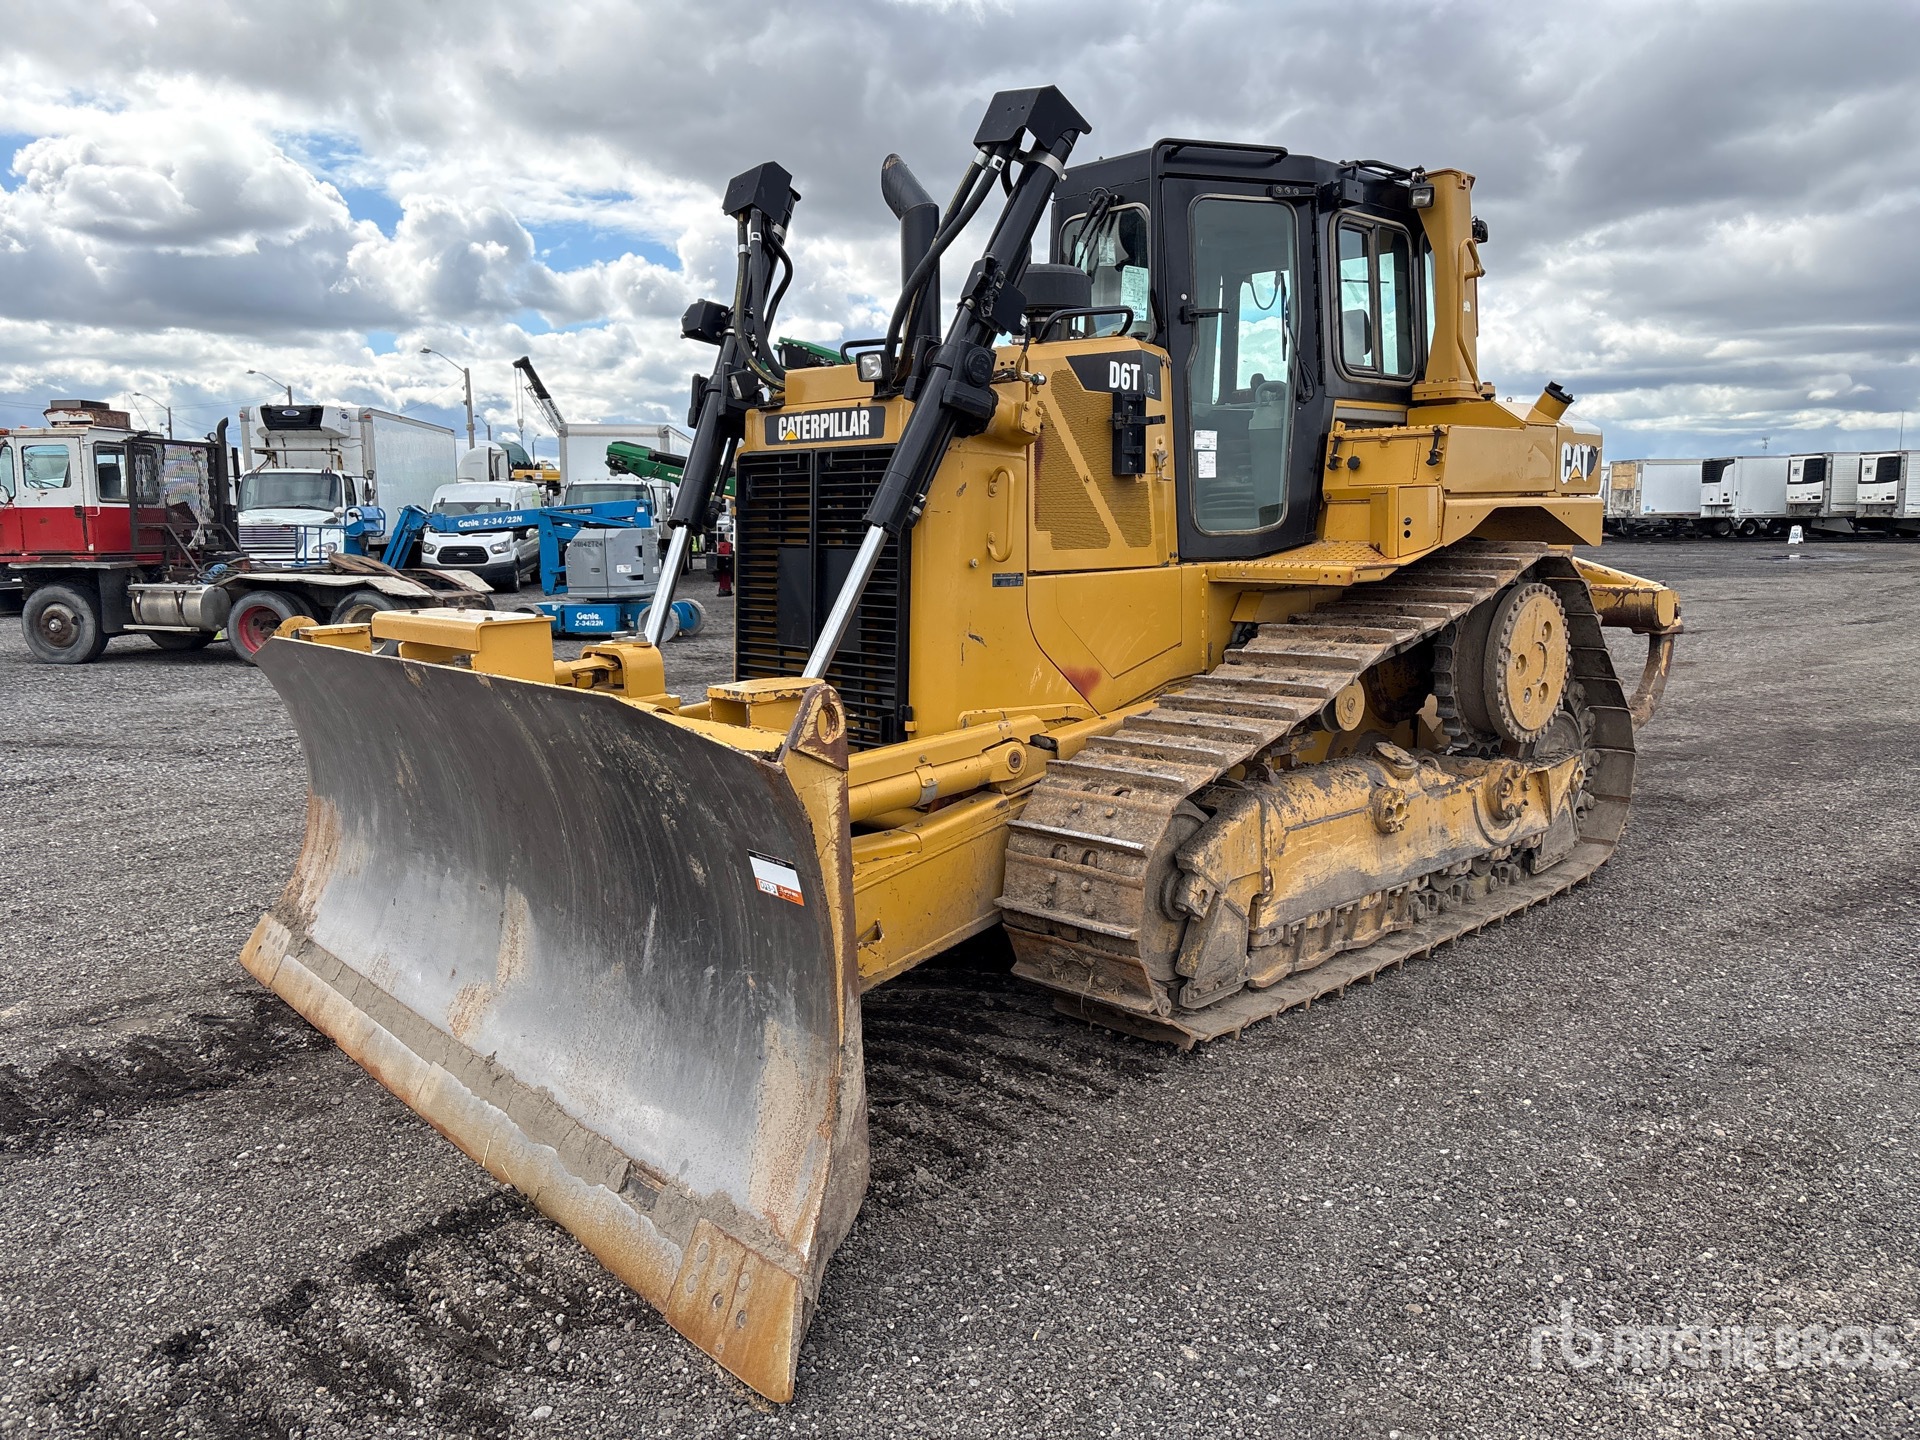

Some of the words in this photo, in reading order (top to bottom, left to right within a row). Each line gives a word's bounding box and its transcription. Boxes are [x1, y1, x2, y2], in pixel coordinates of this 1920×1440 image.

[1109, 361, 1141, 391] D6T
[778, 409, 870, 441] CATERPILLAR
[1560, 441, 1591, 484] CAT
[458, 519, 480, 528] Genie
[483, 515, 523, 526] Z-34/22N
[576, 612, 600, 620] Genie
